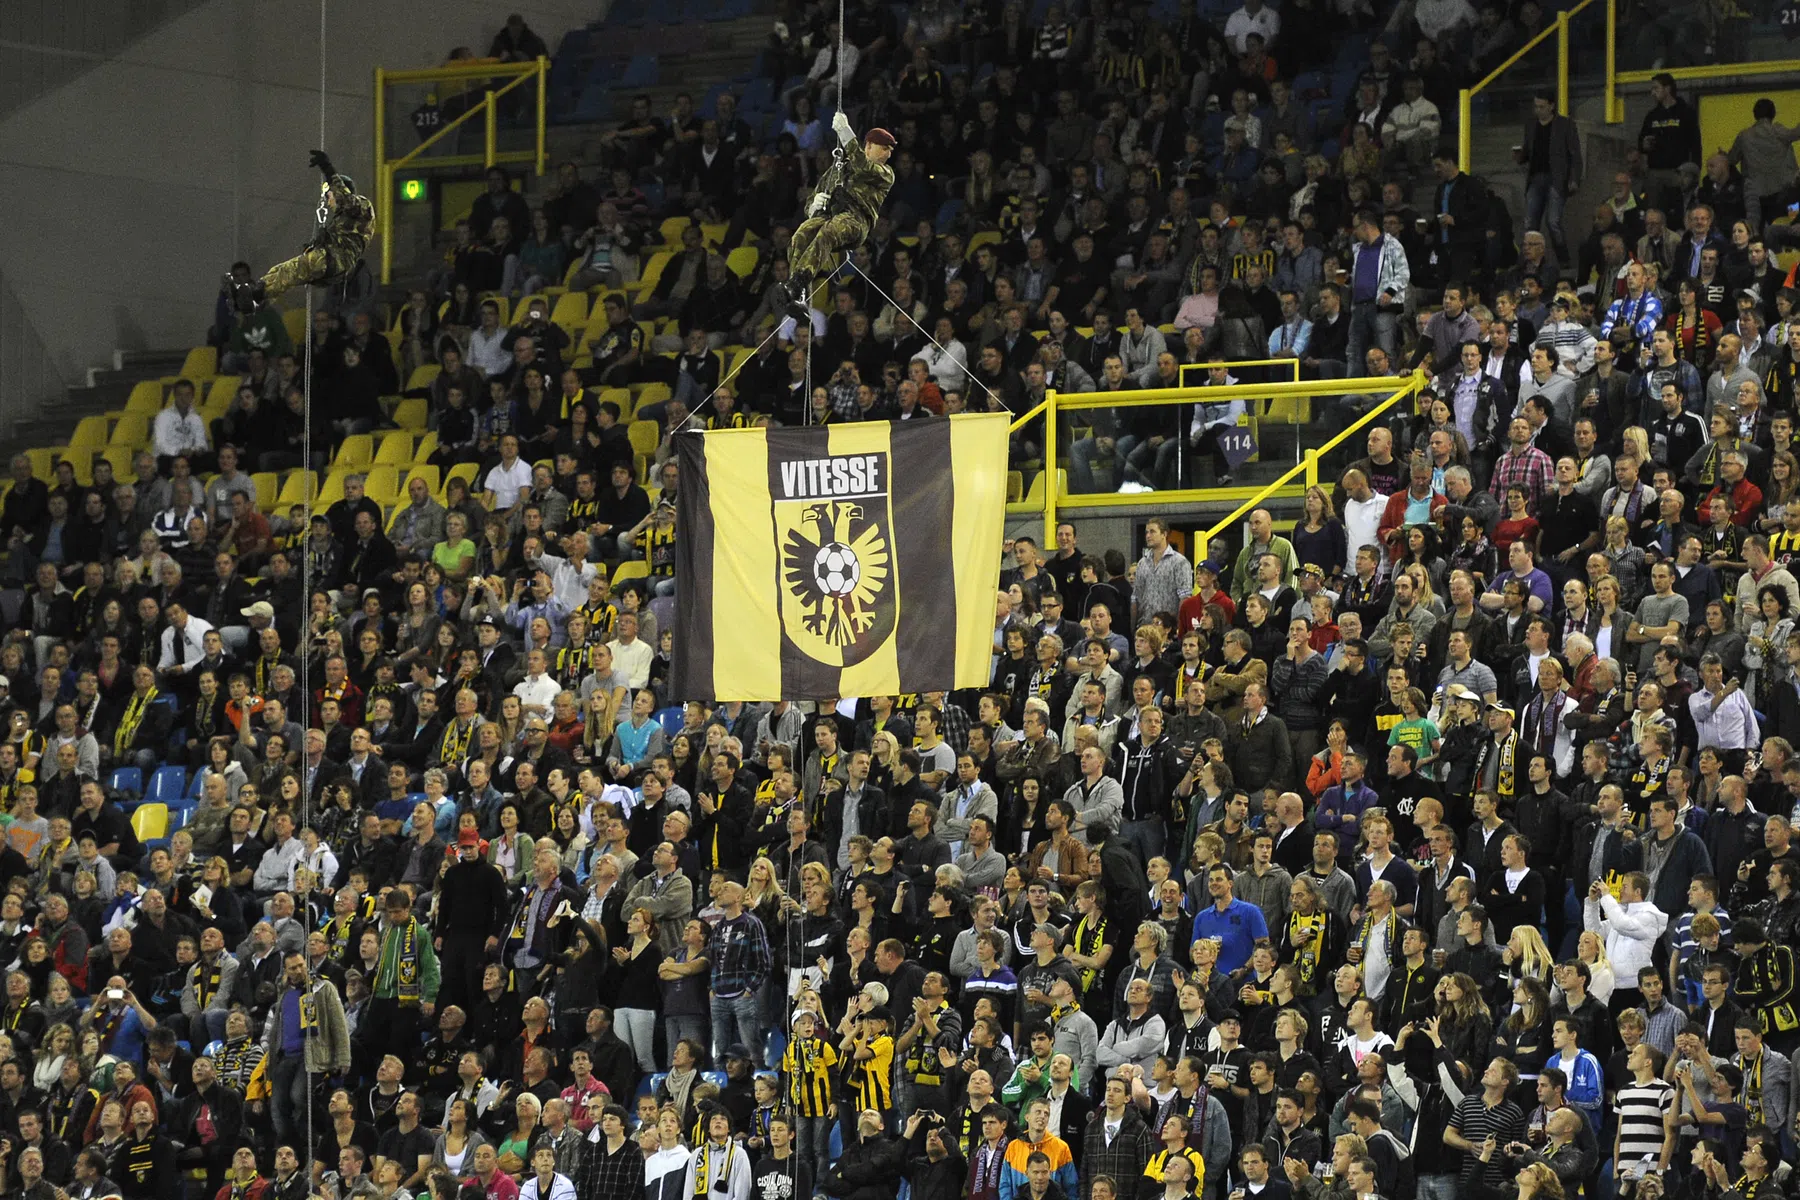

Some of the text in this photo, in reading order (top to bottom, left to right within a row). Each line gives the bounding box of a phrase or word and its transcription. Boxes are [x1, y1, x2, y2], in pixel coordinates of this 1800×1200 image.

[1781, 9, 1800, 25] 21
[416, 112, 439, 127] 215
[1223, 434, 1252, 451] 114
[780, 456, 878, 497] VITESSE
